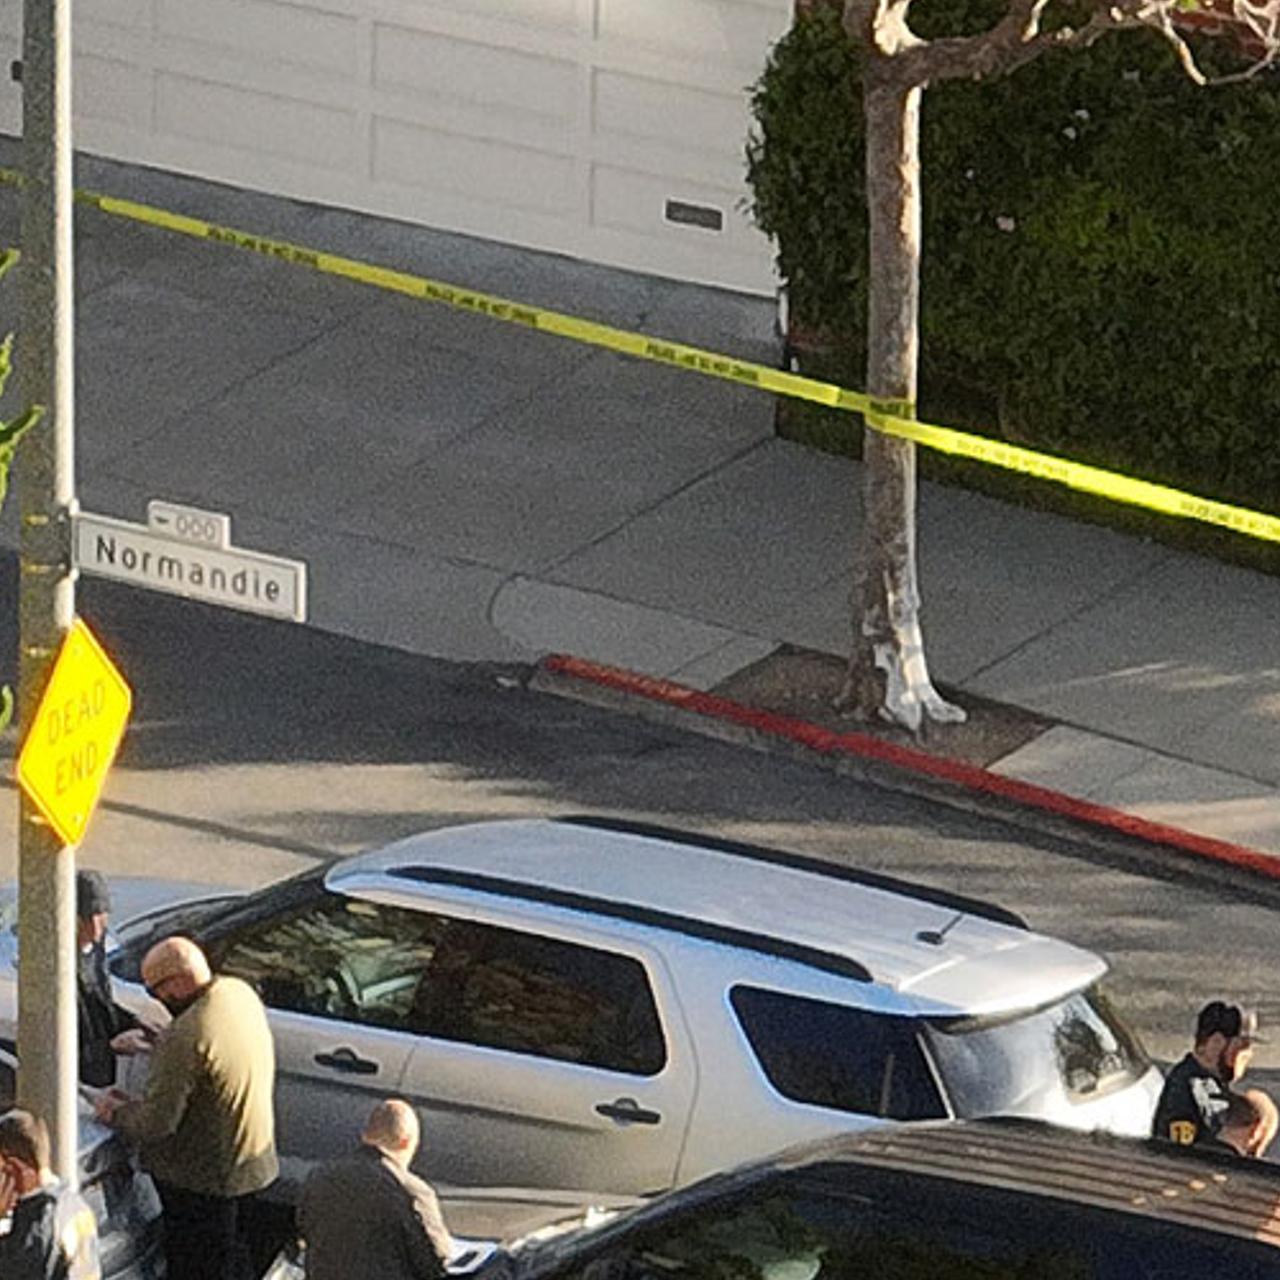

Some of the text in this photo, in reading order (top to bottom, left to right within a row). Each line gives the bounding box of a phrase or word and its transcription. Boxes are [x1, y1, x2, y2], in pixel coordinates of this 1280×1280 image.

[175, 515, 216, 541] 000
[96, 534, 280, 601] Normandie
[47, 677, 105, 745] DEAD
[55, 739, 98, 795] END
